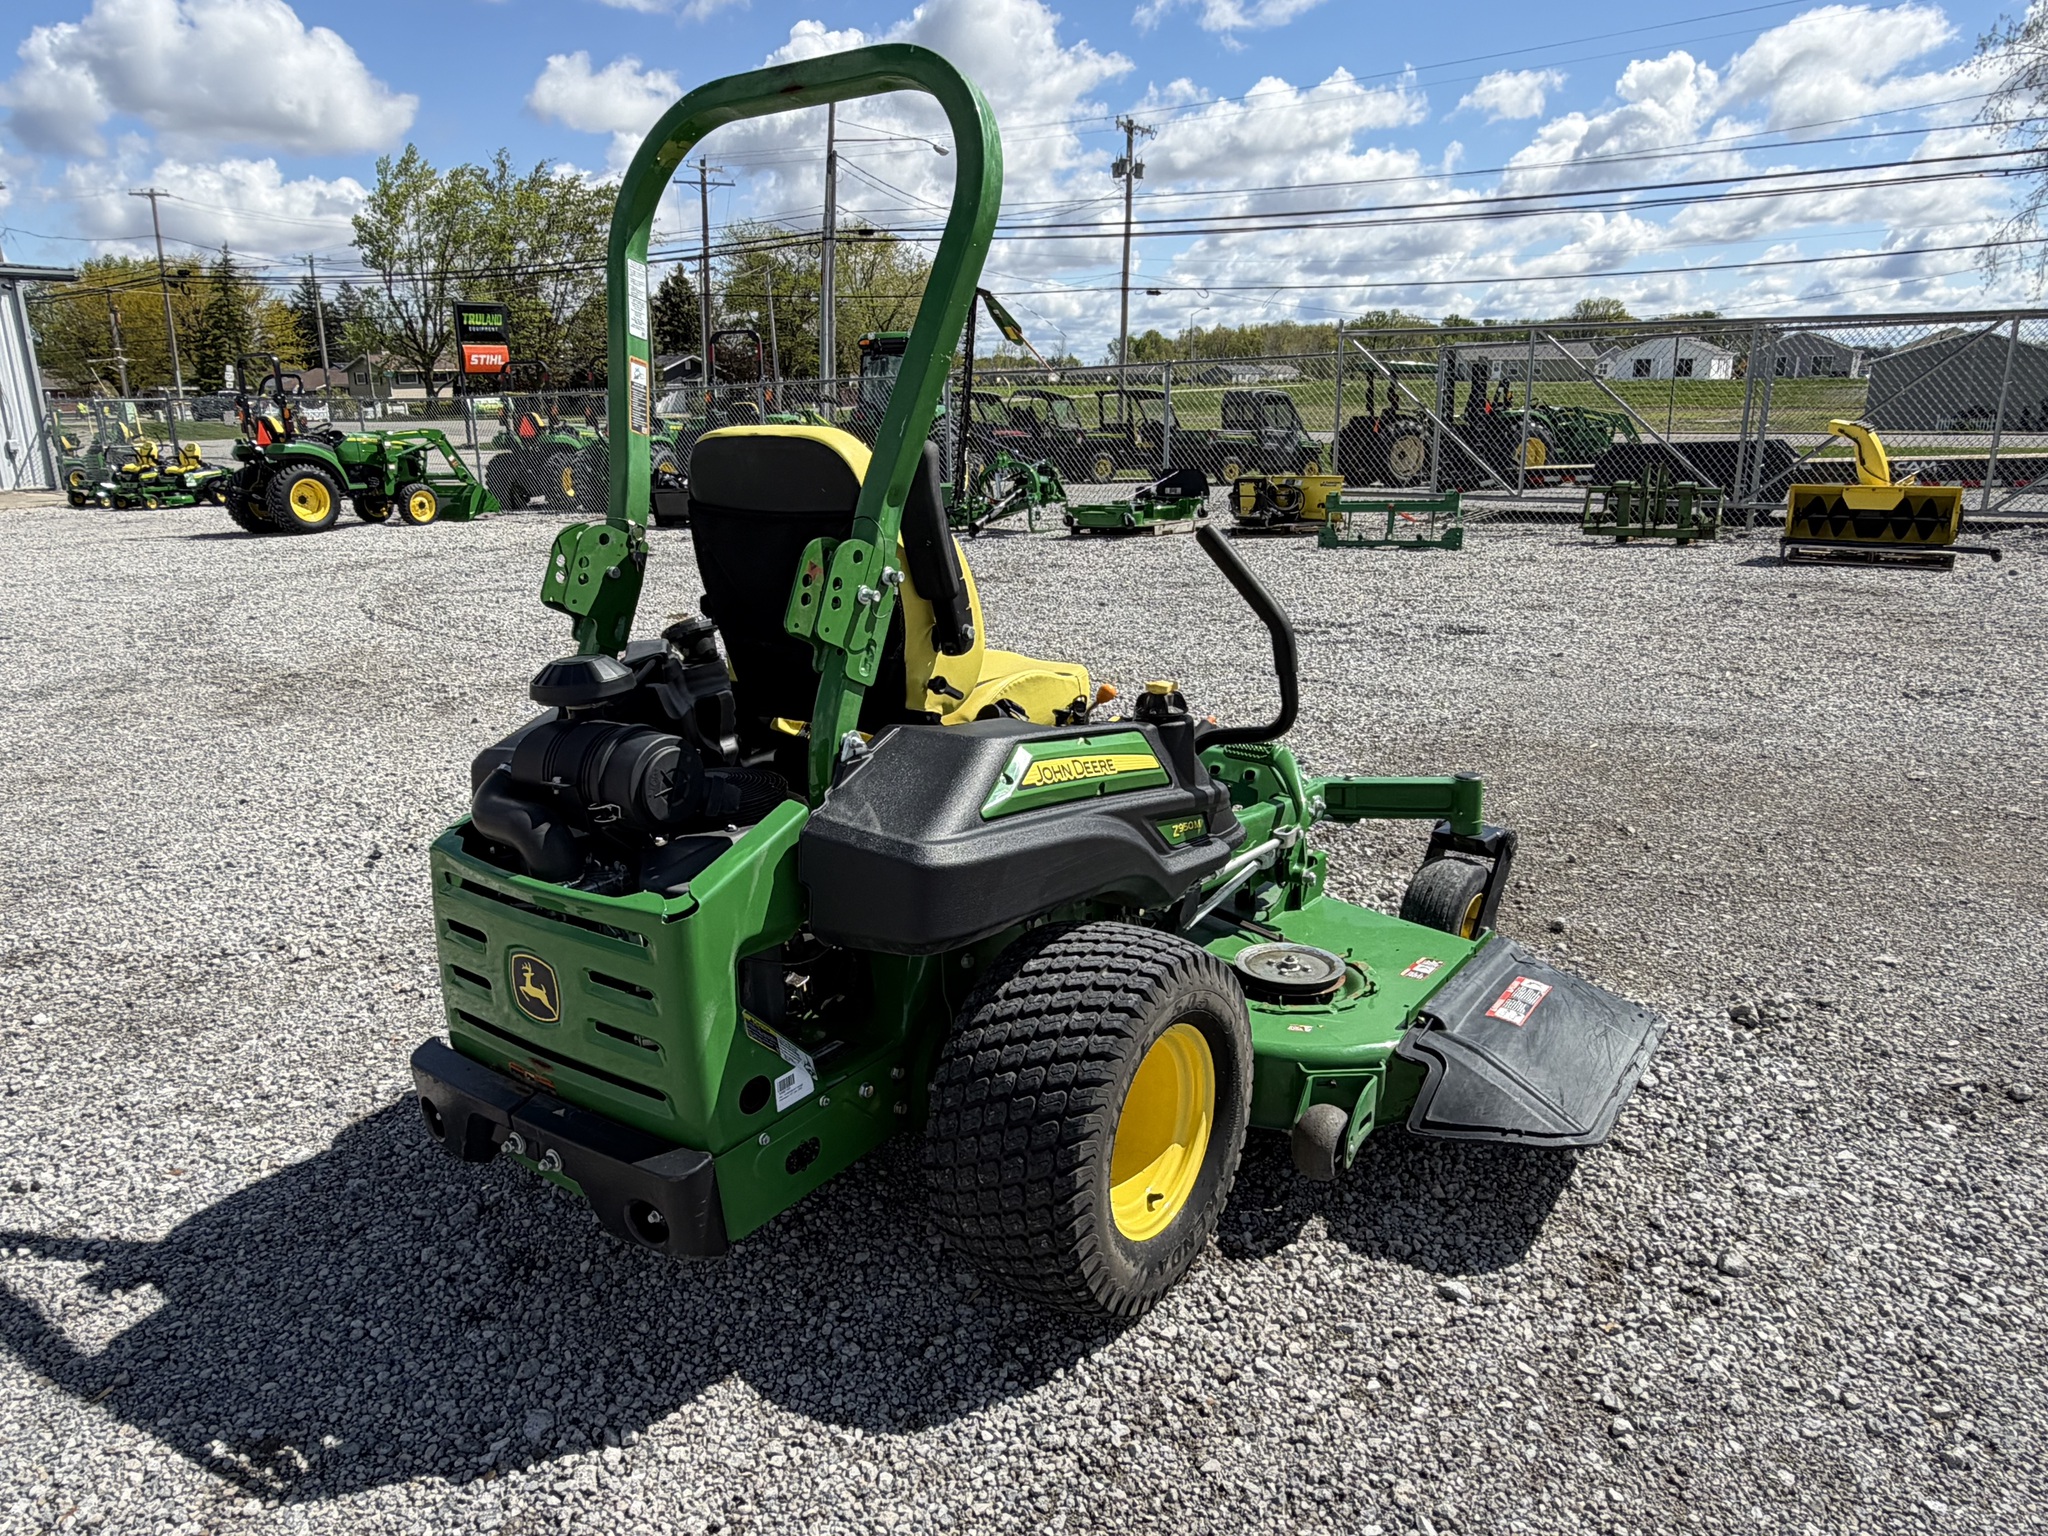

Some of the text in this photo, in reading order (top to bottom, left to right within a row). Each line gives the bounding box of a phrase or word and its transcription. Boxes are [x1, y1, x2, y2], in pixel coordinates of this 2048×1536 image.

[462, 313, 502, 326] TRULAND
[470, 354, 505, 366] STIHL
[1036, 759, 1117, 783] JOHN DEERE
